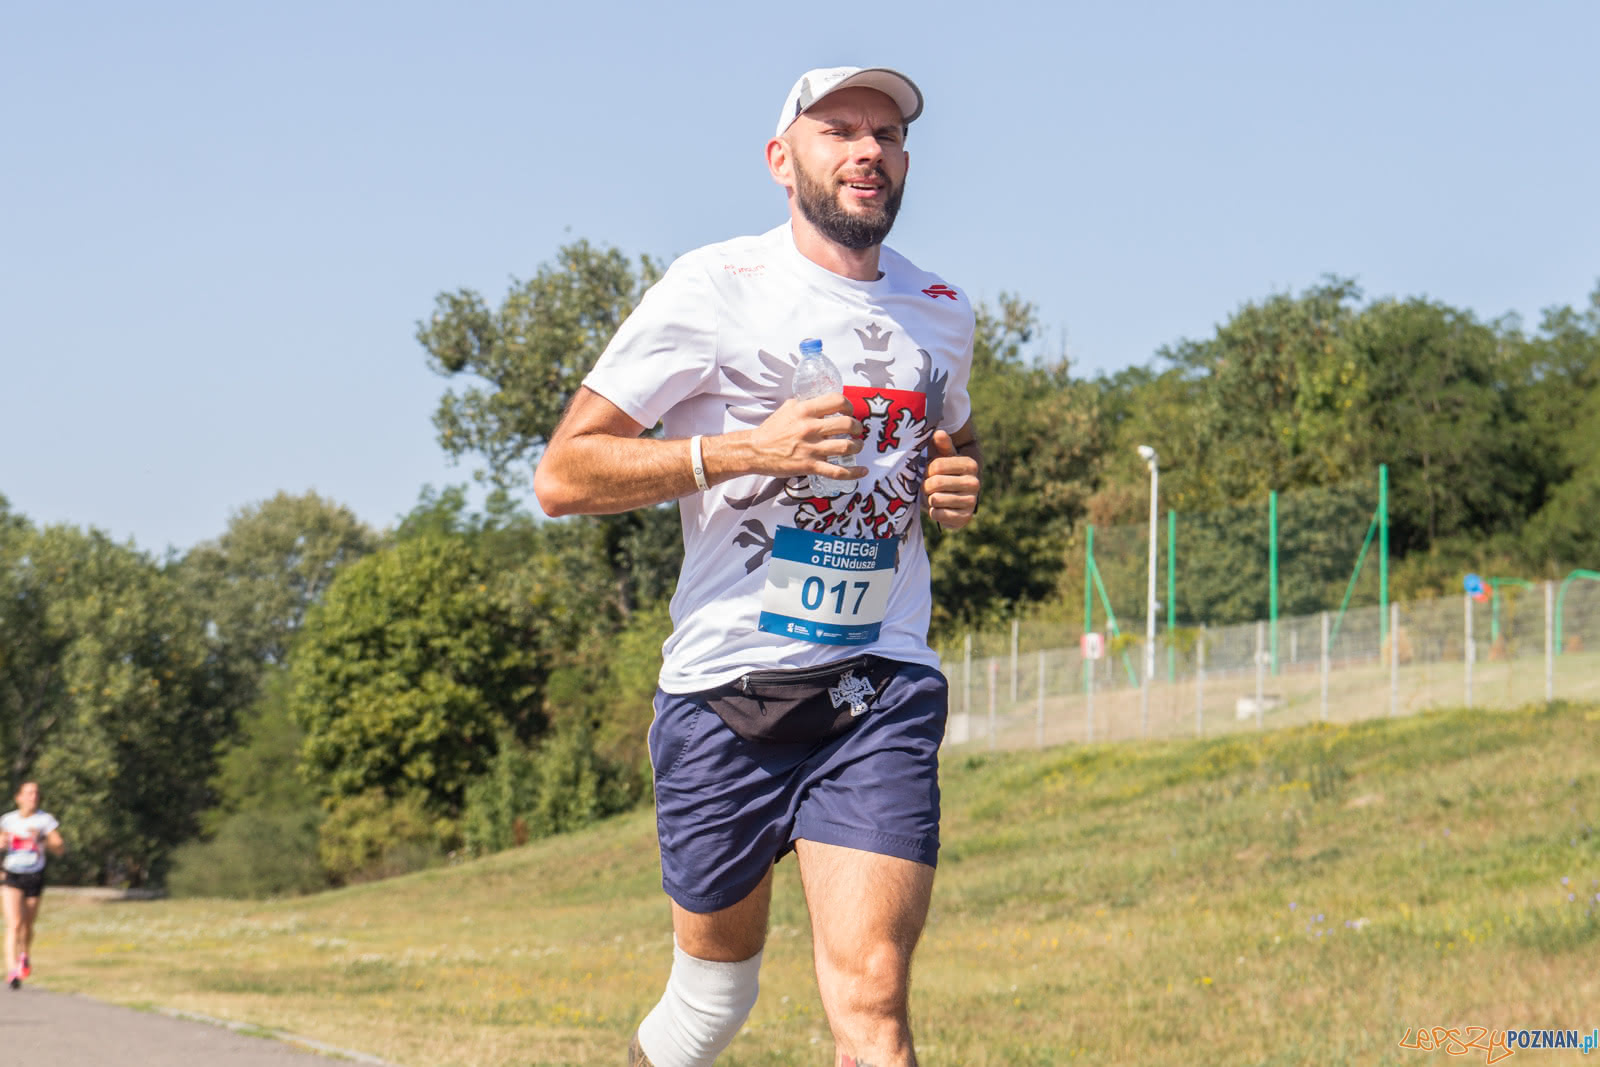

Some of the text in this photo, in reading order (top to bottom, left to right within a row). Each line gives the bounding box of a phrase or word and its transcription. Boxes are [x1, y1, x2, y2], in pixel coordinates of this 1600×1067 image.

[812, 540, 879, 560] zaBIEGaj
[811, 554, 876, 569] o FUNdusze
[801, 575, 870, 615] 017
